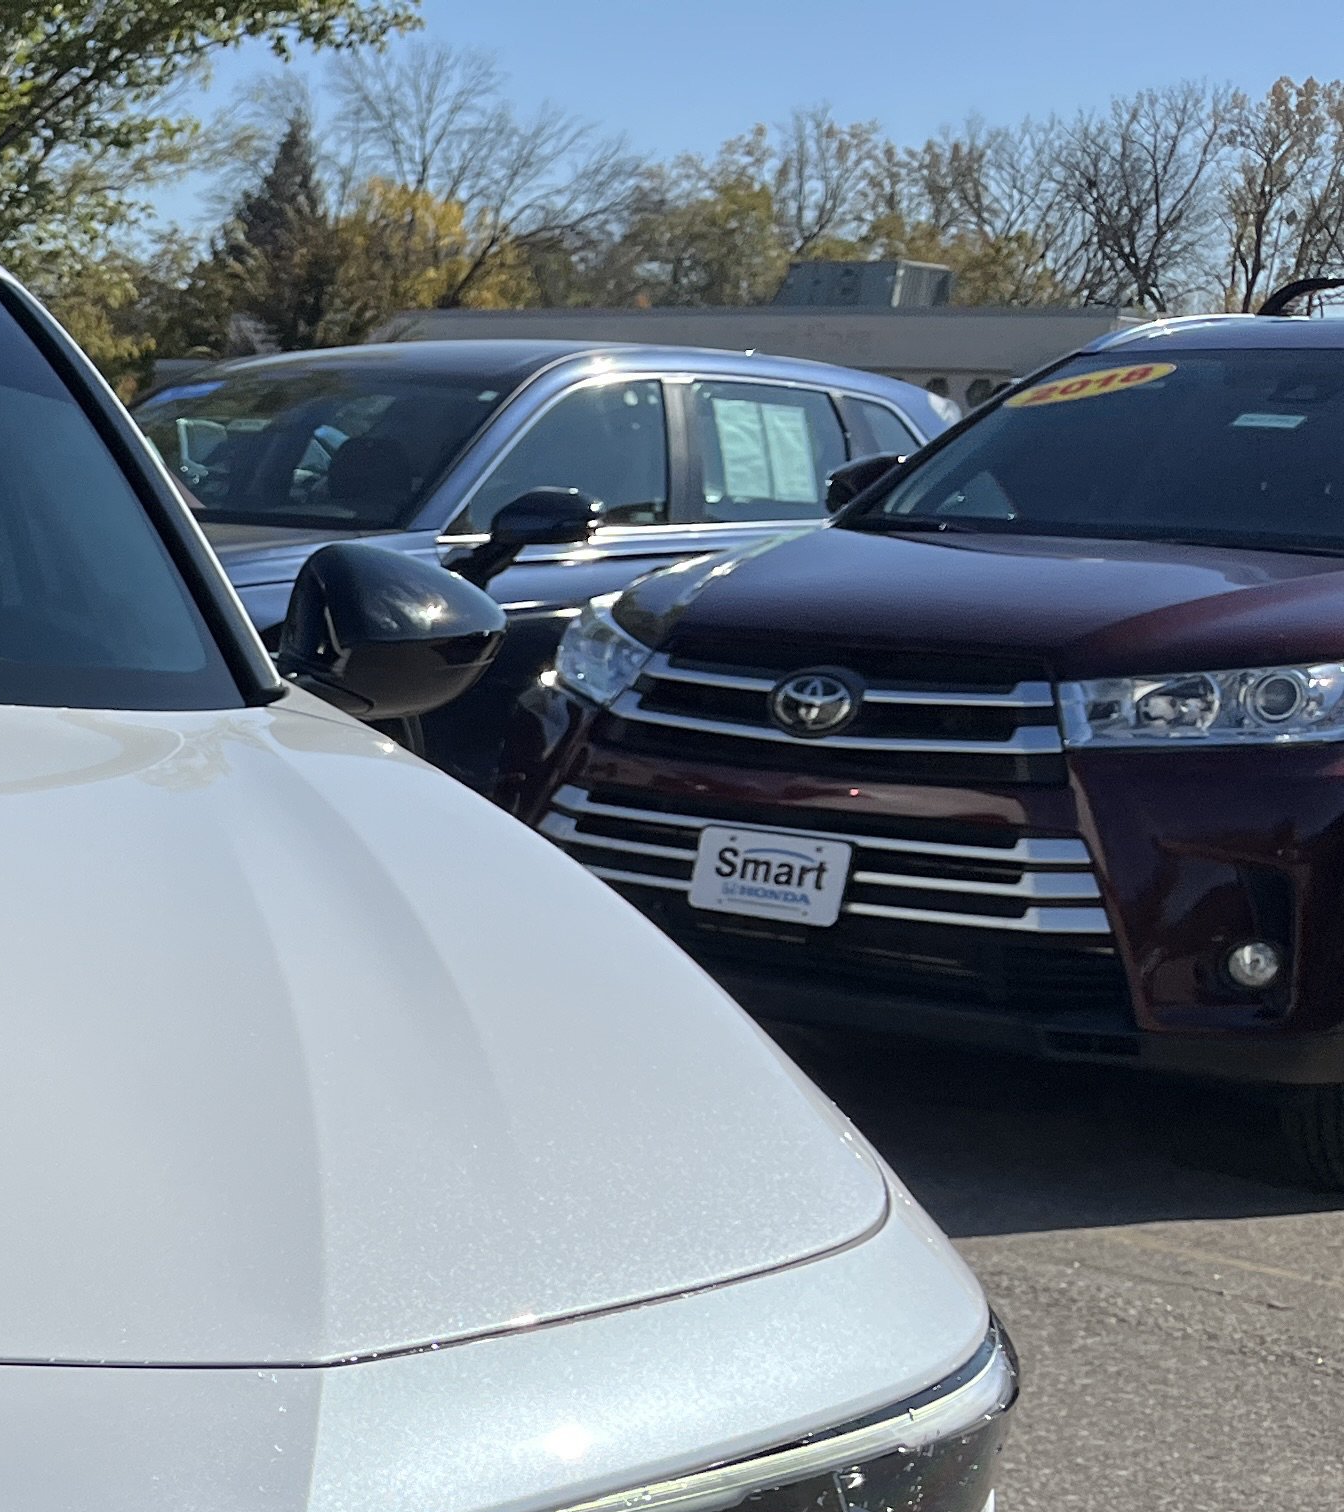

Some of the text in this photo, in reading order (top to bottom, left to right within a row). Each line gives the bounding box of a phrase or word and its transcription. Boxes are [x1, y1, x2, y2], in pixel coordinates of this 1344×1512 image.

[1024, 367, 1154, 403] 2018
[715, 847, 827, 889] Smart
[738, 884, 811, 905] HONDA
